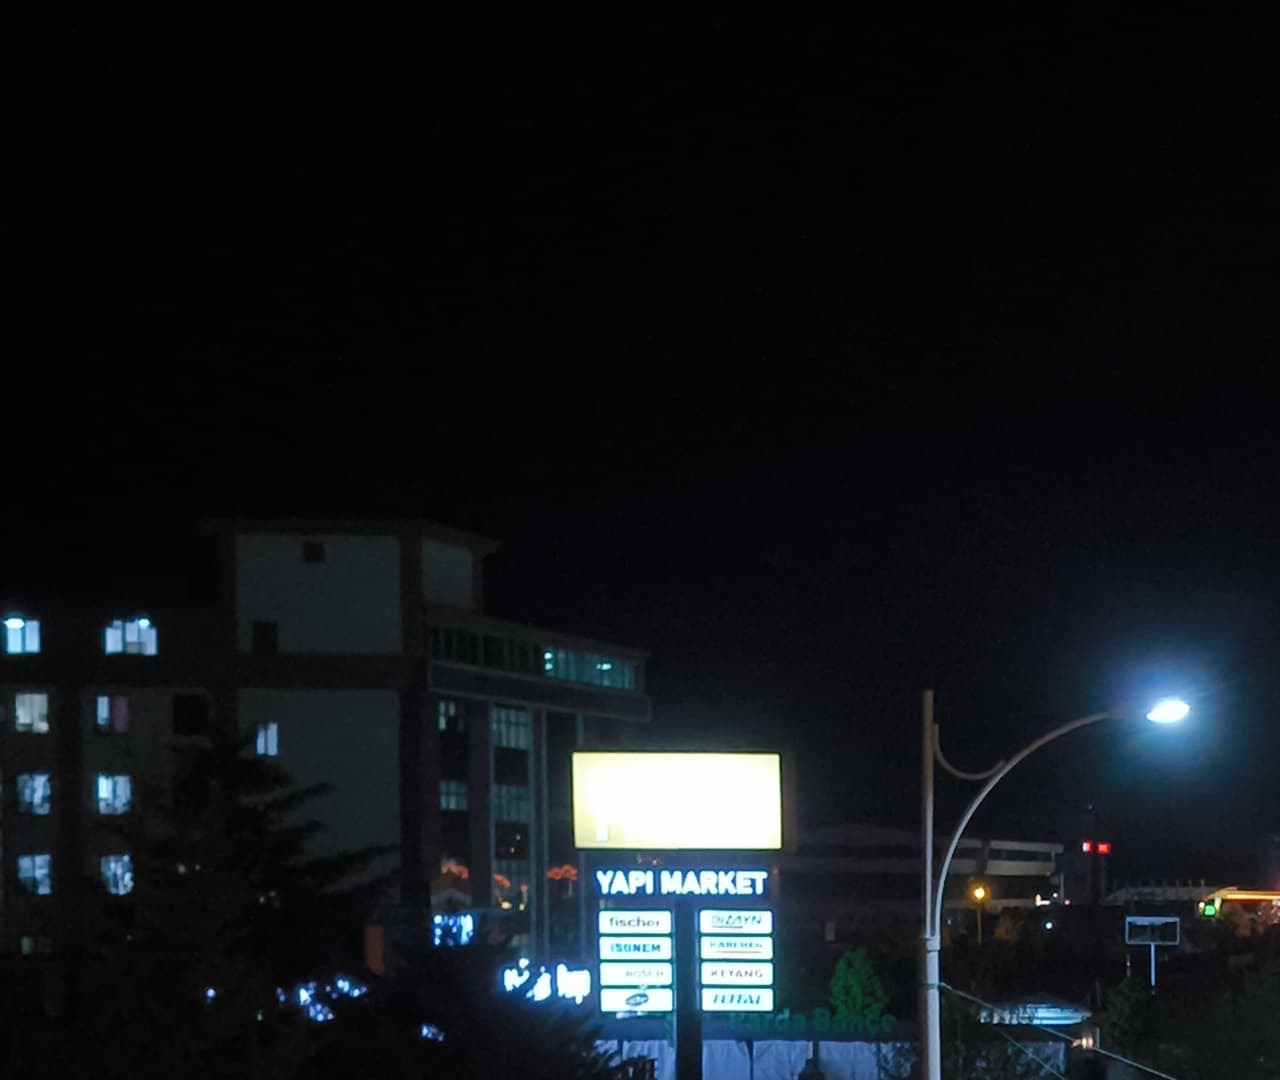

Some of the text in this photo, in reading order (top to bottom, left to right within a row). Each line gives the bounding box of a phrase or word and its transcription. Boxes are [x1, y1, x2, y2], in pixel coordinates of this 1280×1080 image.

[596, 870, 768, 895] YAPI MARKET
[609, 916, 660, 927] fischer
